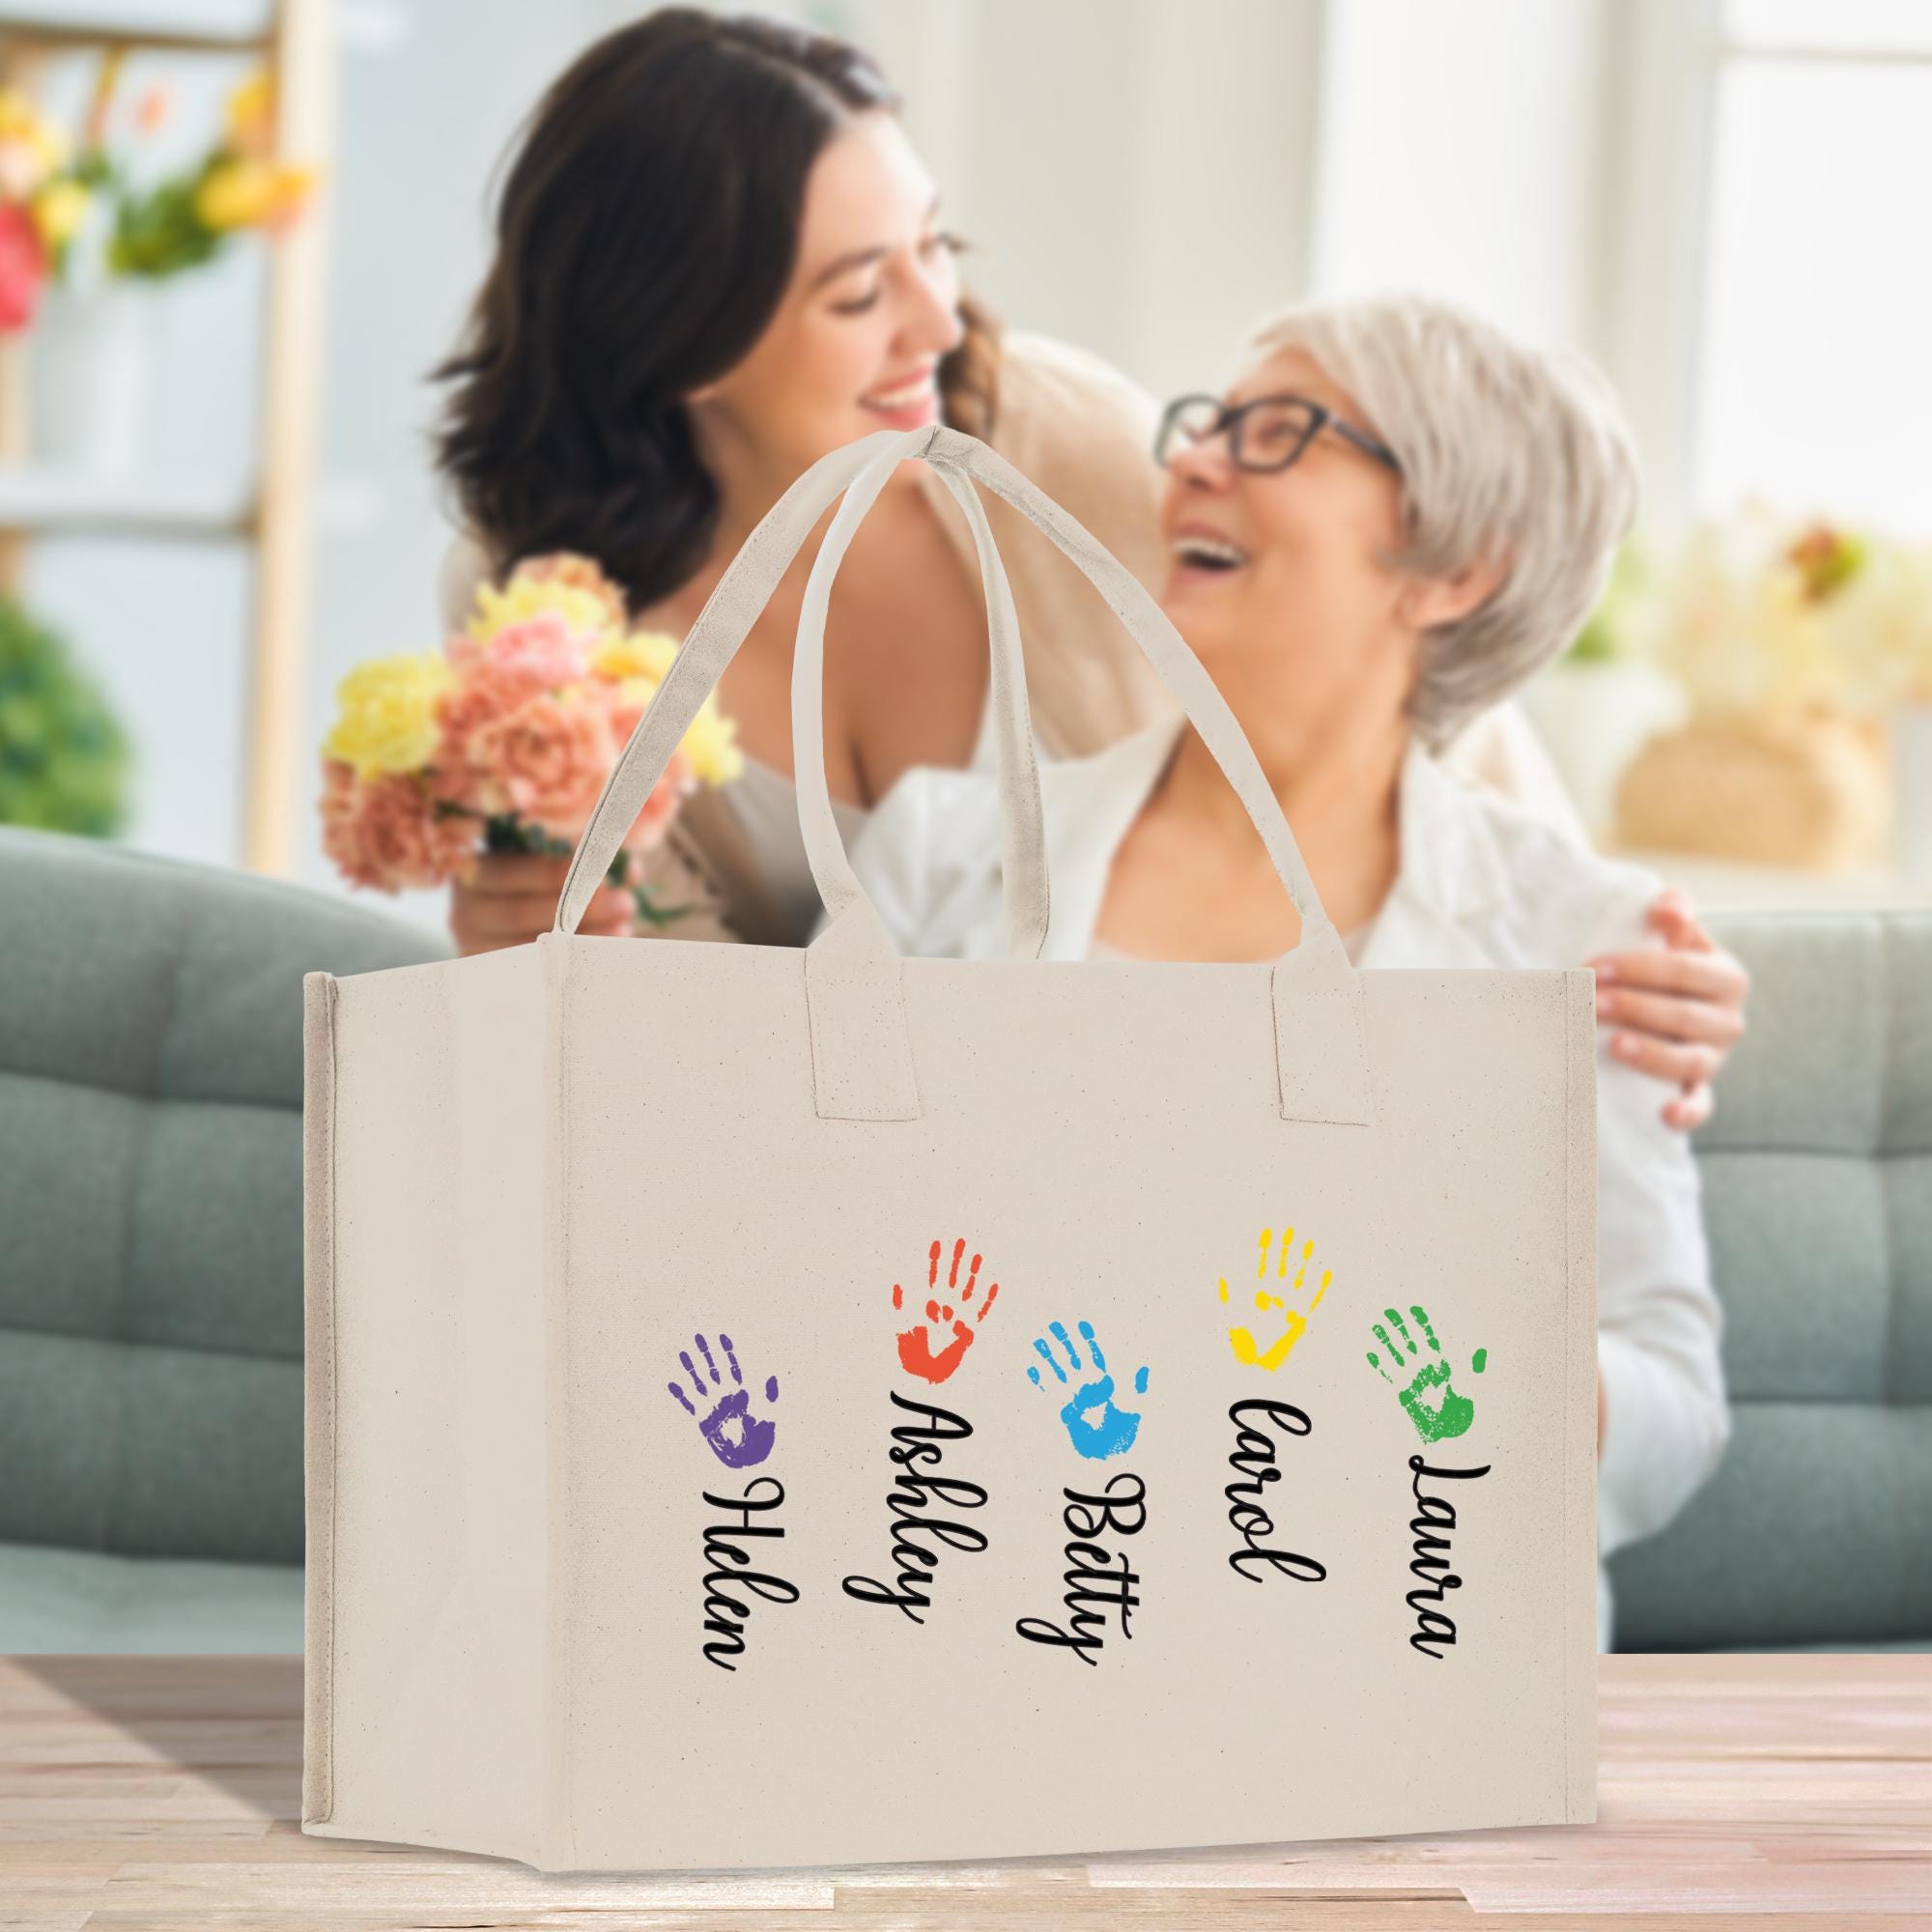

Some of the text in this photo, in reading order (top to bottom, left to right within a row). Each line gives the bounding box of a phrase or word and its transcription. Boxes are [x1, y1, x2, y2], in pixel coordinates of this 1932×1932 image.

[702, 1477, 800, 1672] Helen
[841, 1390, 988, 1625] Ashley
[1015, 1473, 1147, 1667] Betty
[1224, 1399, 1327, 1583] Carol
[1406, 1454, 1492, 1660] Laura
